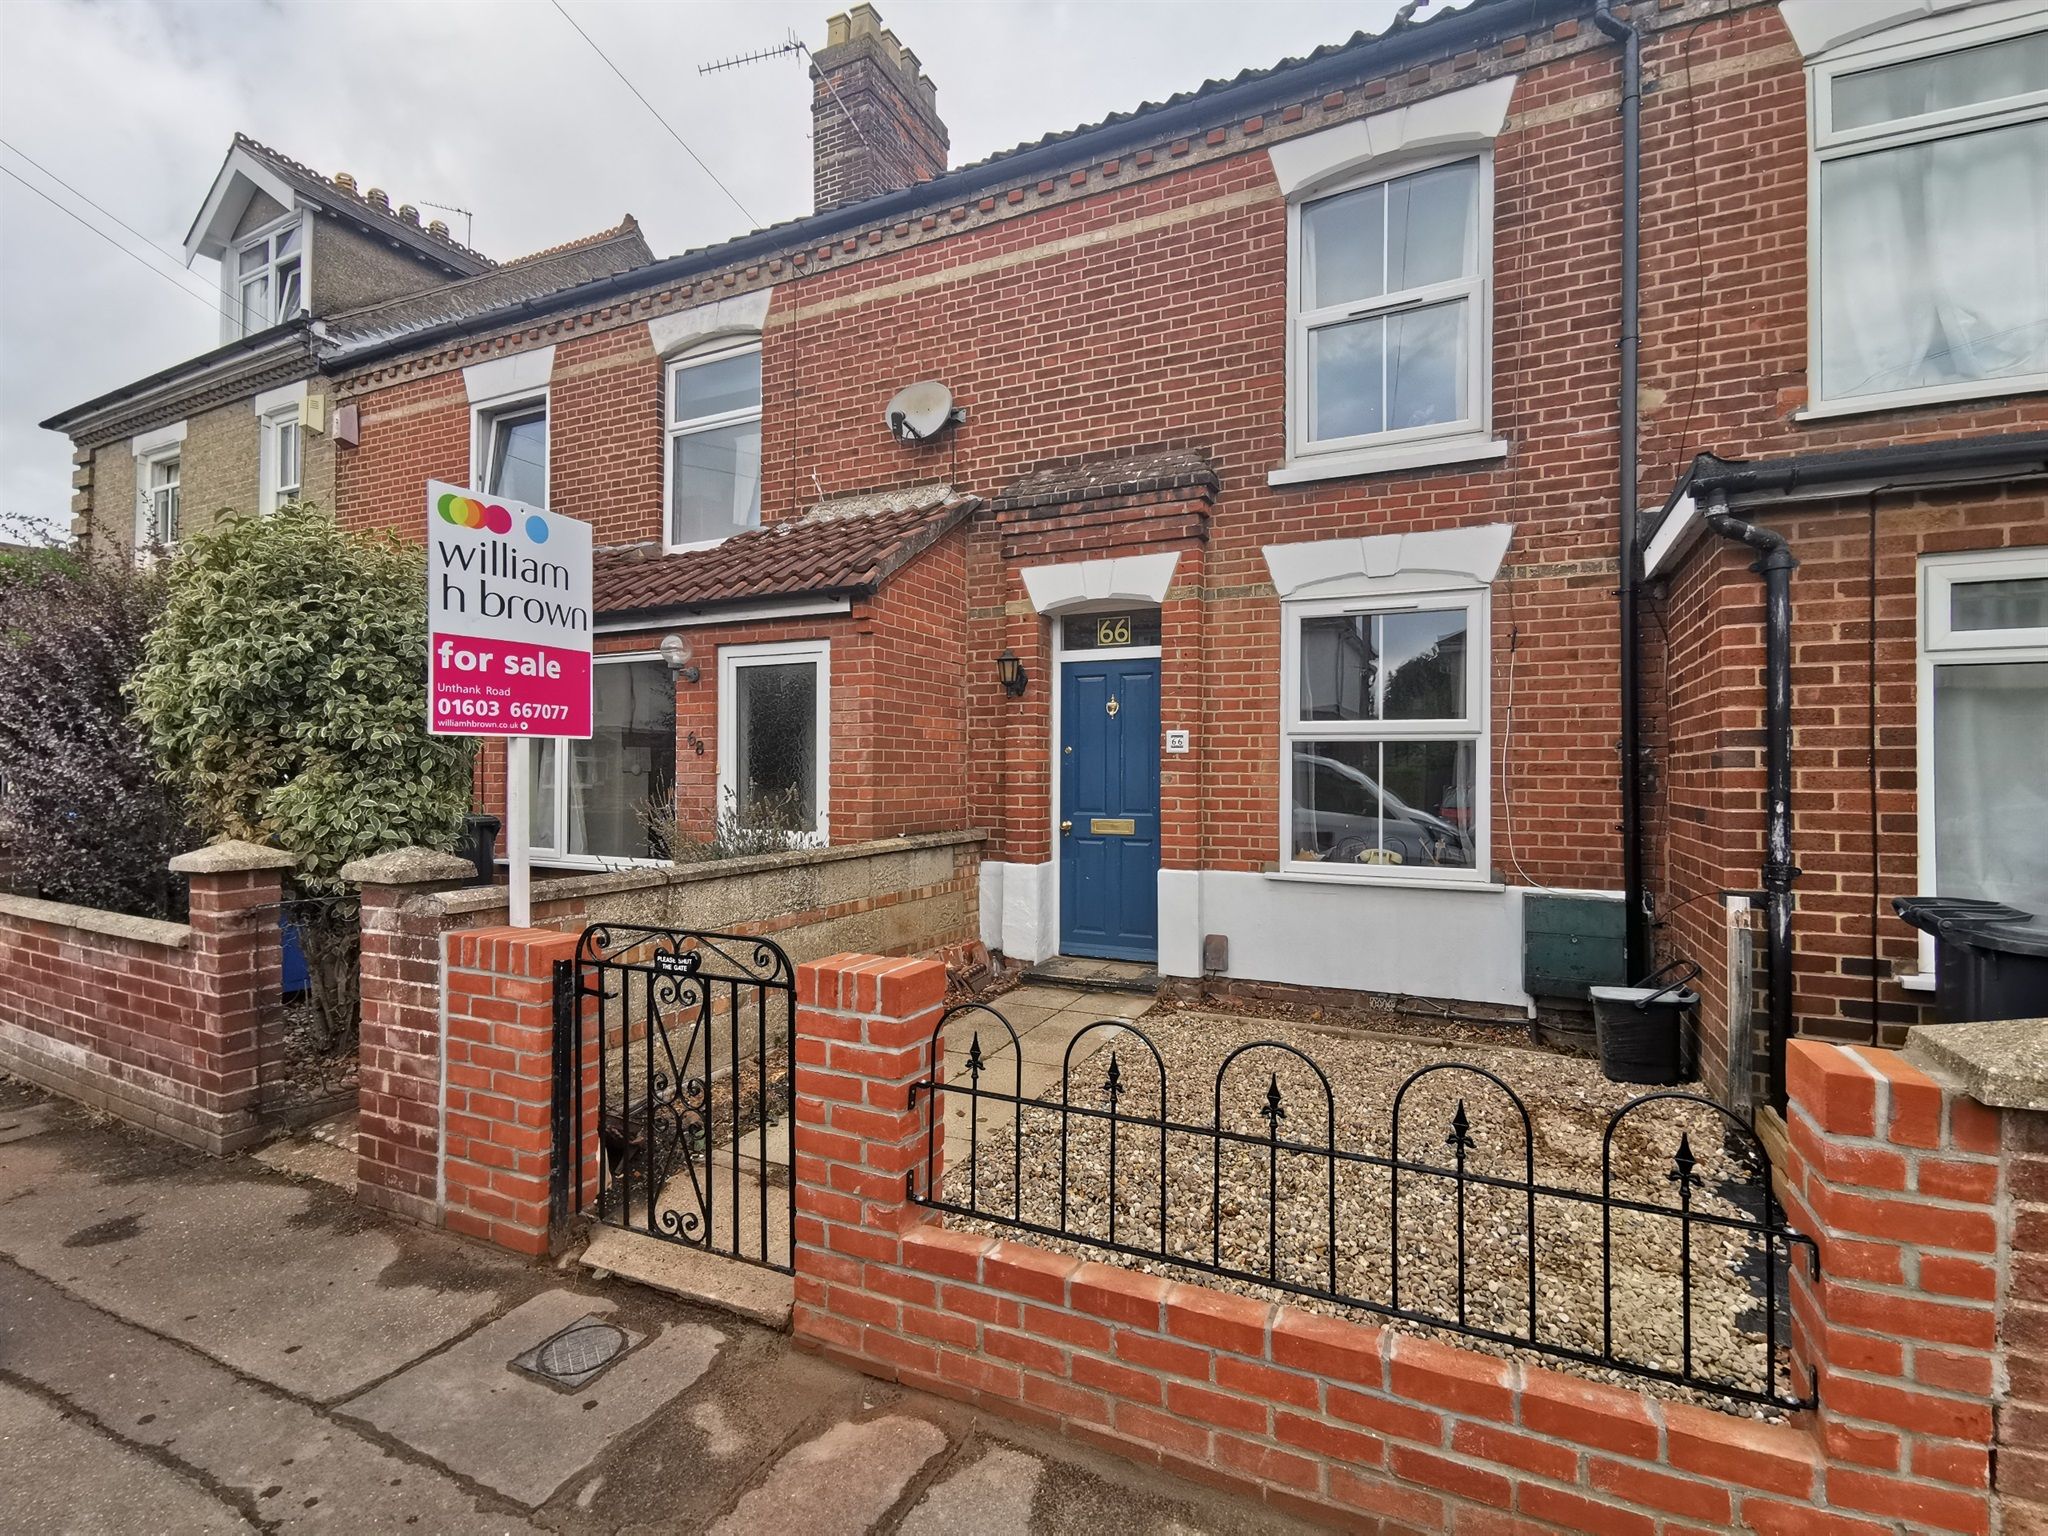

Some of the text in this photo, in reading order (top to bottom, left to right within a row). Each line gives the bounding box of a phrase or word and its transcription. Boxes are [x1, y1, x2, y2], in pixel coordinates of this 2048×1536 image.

[438, 540, 569, 590] william
[443, 573, 587, 631] h brown
[1100, 619, 1128, 643] 66
[438, 641, 561, 679] for sale
[437, 683, 511, 696] Unthank Road
[438, 698, 569, 720] 01603 667077
[438, 719, 519, 729] williamhbrown.co.uk
[687, 731, 704, 756] 68
[1171, 738, 1183, 746] 66
[657, 955, 676, 964] PLEASE
[662, 963, 687, 972] THE GATE
